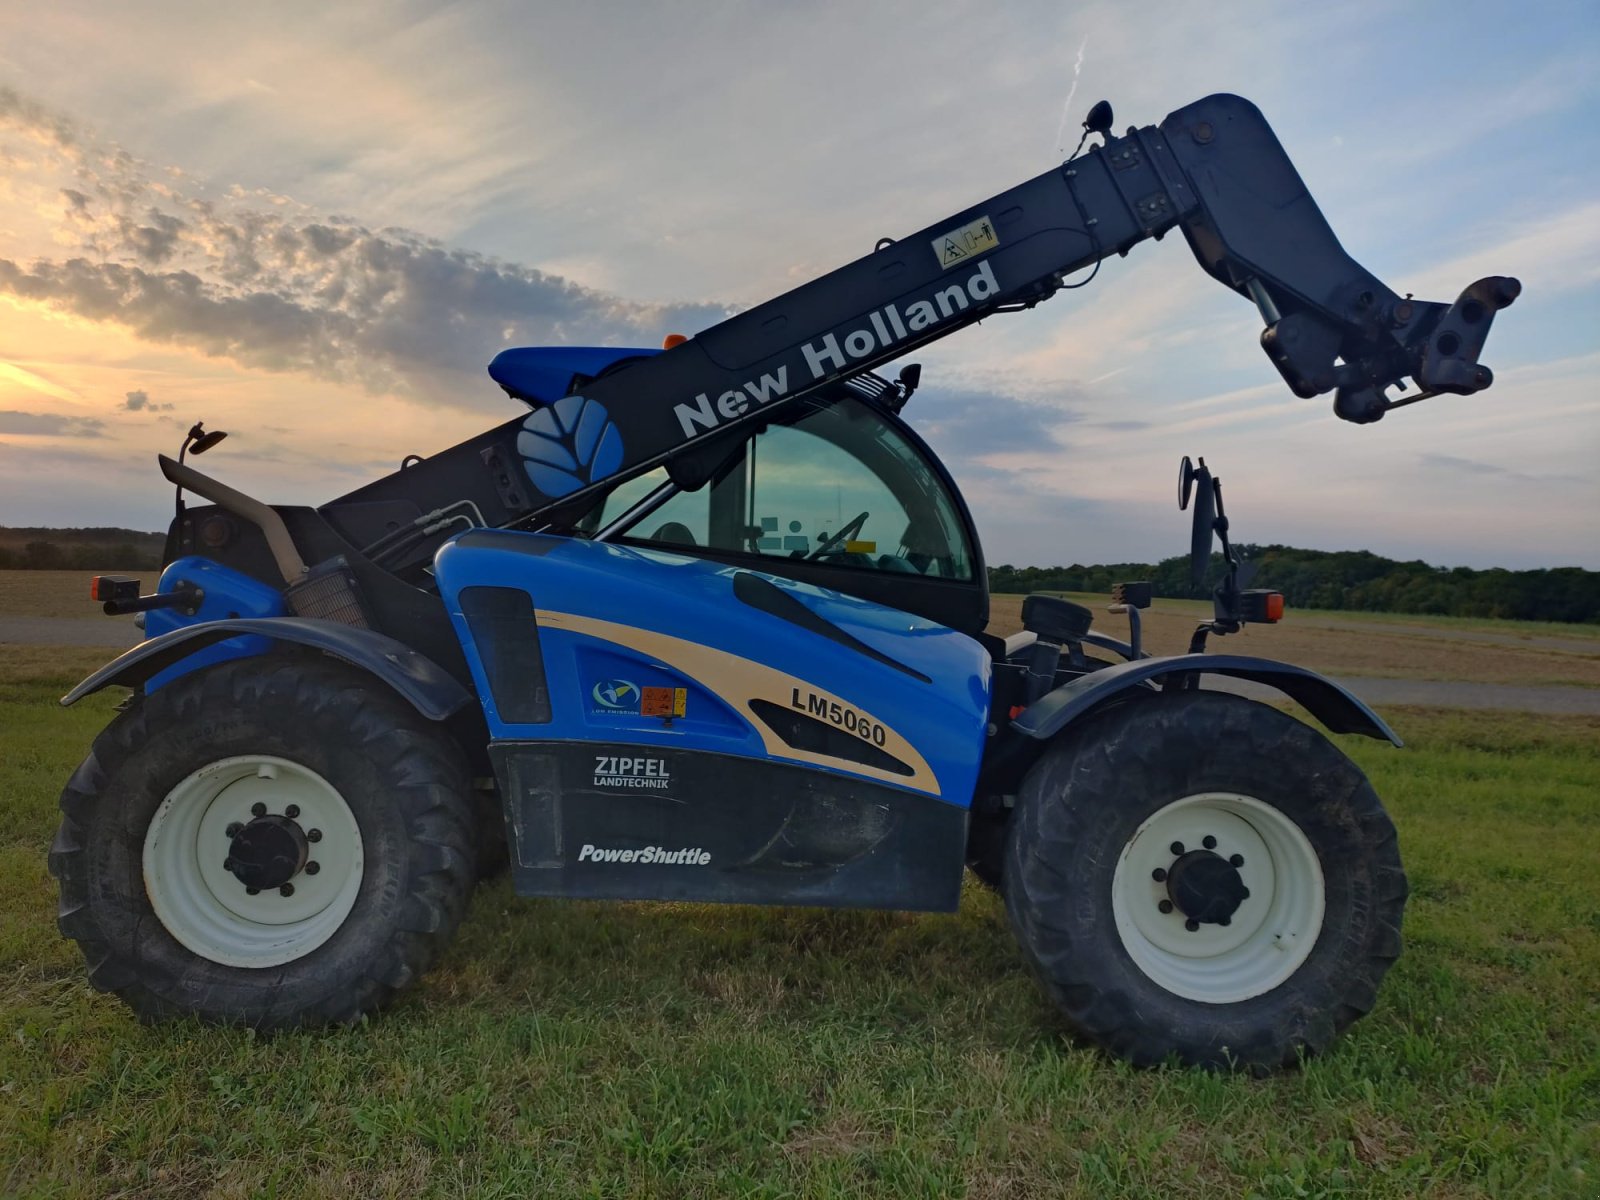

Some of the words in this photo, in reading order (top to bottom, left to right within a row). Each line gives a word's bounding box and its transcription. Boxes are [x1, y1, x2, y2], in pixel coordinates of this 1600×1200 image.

[673, 364, 789, 439] New
[801, 261, 1000, 379] Holland
[791, 687, 886, 747] LM5060
[594, 756, 670, 776] ZIPFEL
[594, 776, 669, 789] LANDTECHNIK
[578, 844, 712, 866] PowerShuttle
